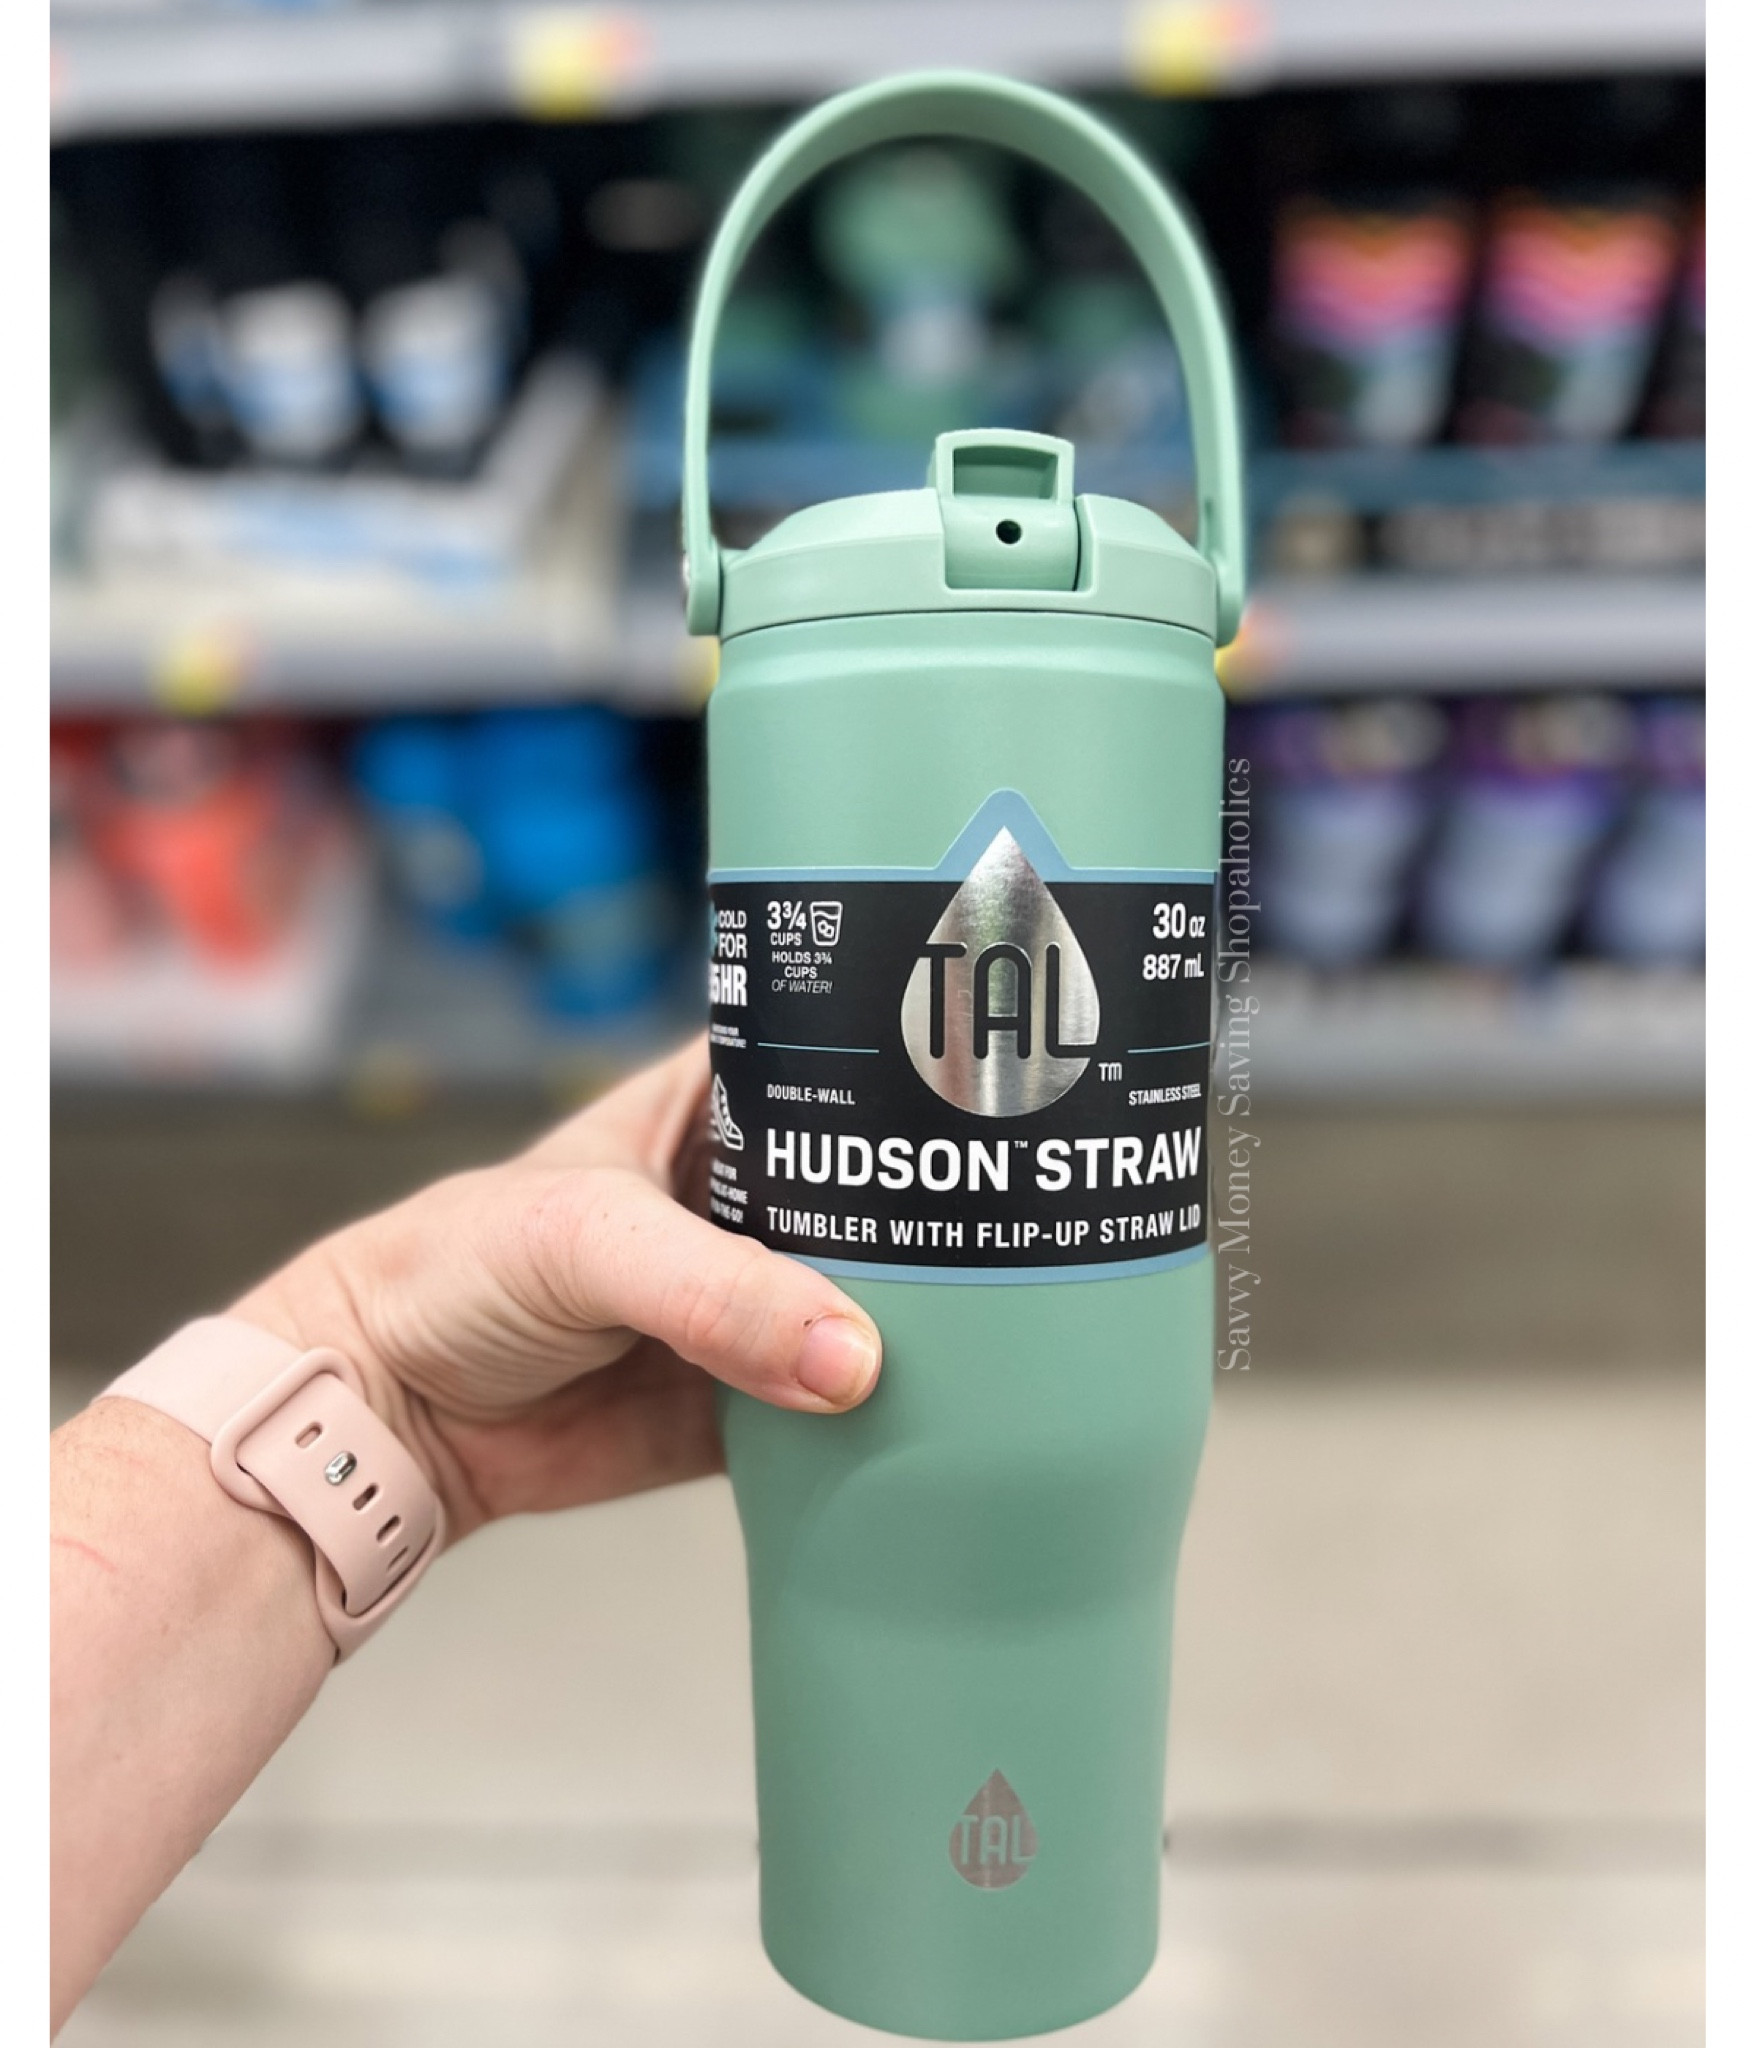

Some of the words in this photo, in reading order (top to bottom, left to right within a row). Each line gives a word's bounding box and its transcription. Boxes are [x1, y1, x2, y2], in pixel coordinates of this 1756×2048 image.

[718, 910, 747, 929] COLD
[1152, 902, 1186, 939] 30
[1189, 915, 1206, 938] oz
[718, 933, 748, 959] FOR
[770, 932, 803, 946] CUPS
[771, 951, 812, 964] HOLDS
[1142, 953, 1182, 980] 887
[1184, 952, 1205, 978] mL
[784, 966, 818, 980] CUPS
[771, 979, 788, 992] OF
[789, 980, 833, 994] WATER!
[912, 942, 1098, 1059] TAL
[767, 1084, 856, 1105] DOUBLE-WALL
[1128, 1086, 1181, 1106] STAINLESS
[1181, 1083, 1201, 1100] STEEL
[1035, 1126, 1201, 1192] STRAW
[766, 1205, 877, 1243] TUMBLER
[889, 1219, 963, 1248] WITH
[976, 1220, 1090, 1248] FLIP-UP
[1099, 1210, 1173, 1244] STRAW
[1179, 1203, 1201, 1232] LID
[959, 1814, 1036, 1865] TAL
